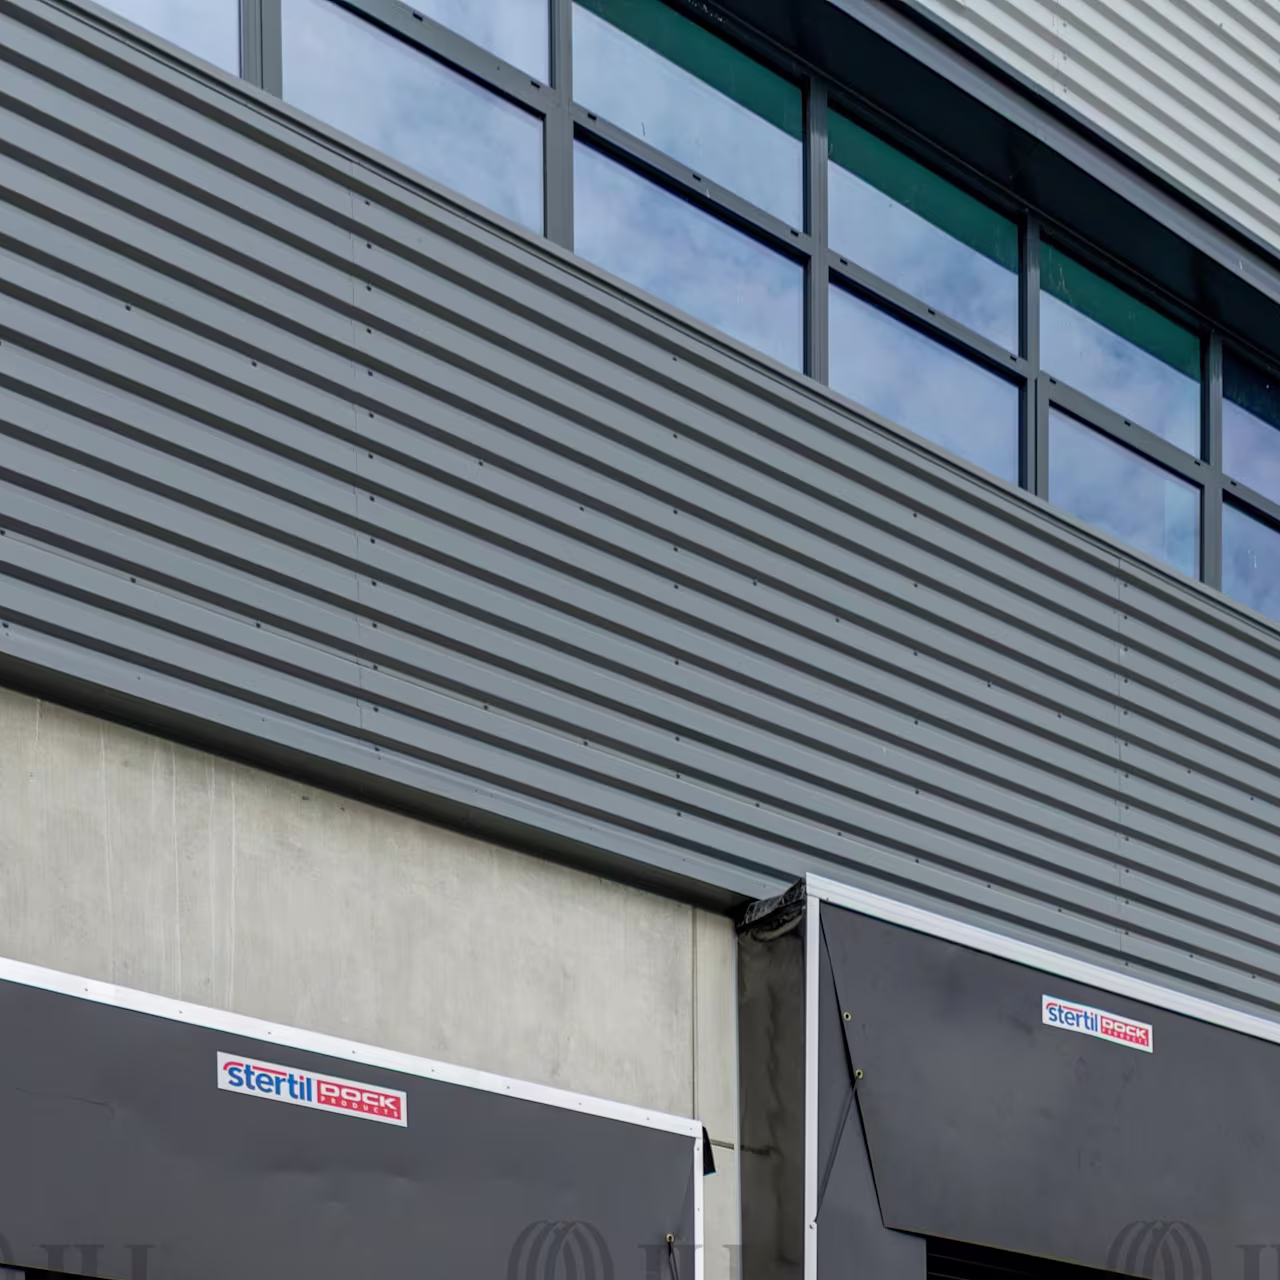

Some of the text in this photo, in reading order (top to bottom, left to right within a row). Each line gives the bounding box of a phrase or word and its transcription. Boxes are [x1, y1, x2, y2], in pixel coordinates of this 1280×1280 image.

[1049, 1004, 1147, 1039] stertil DOCK
[228, 1063, 398, 1110] stertil DOCK
[320, 1095, 399, 1118] PRODUCTS
